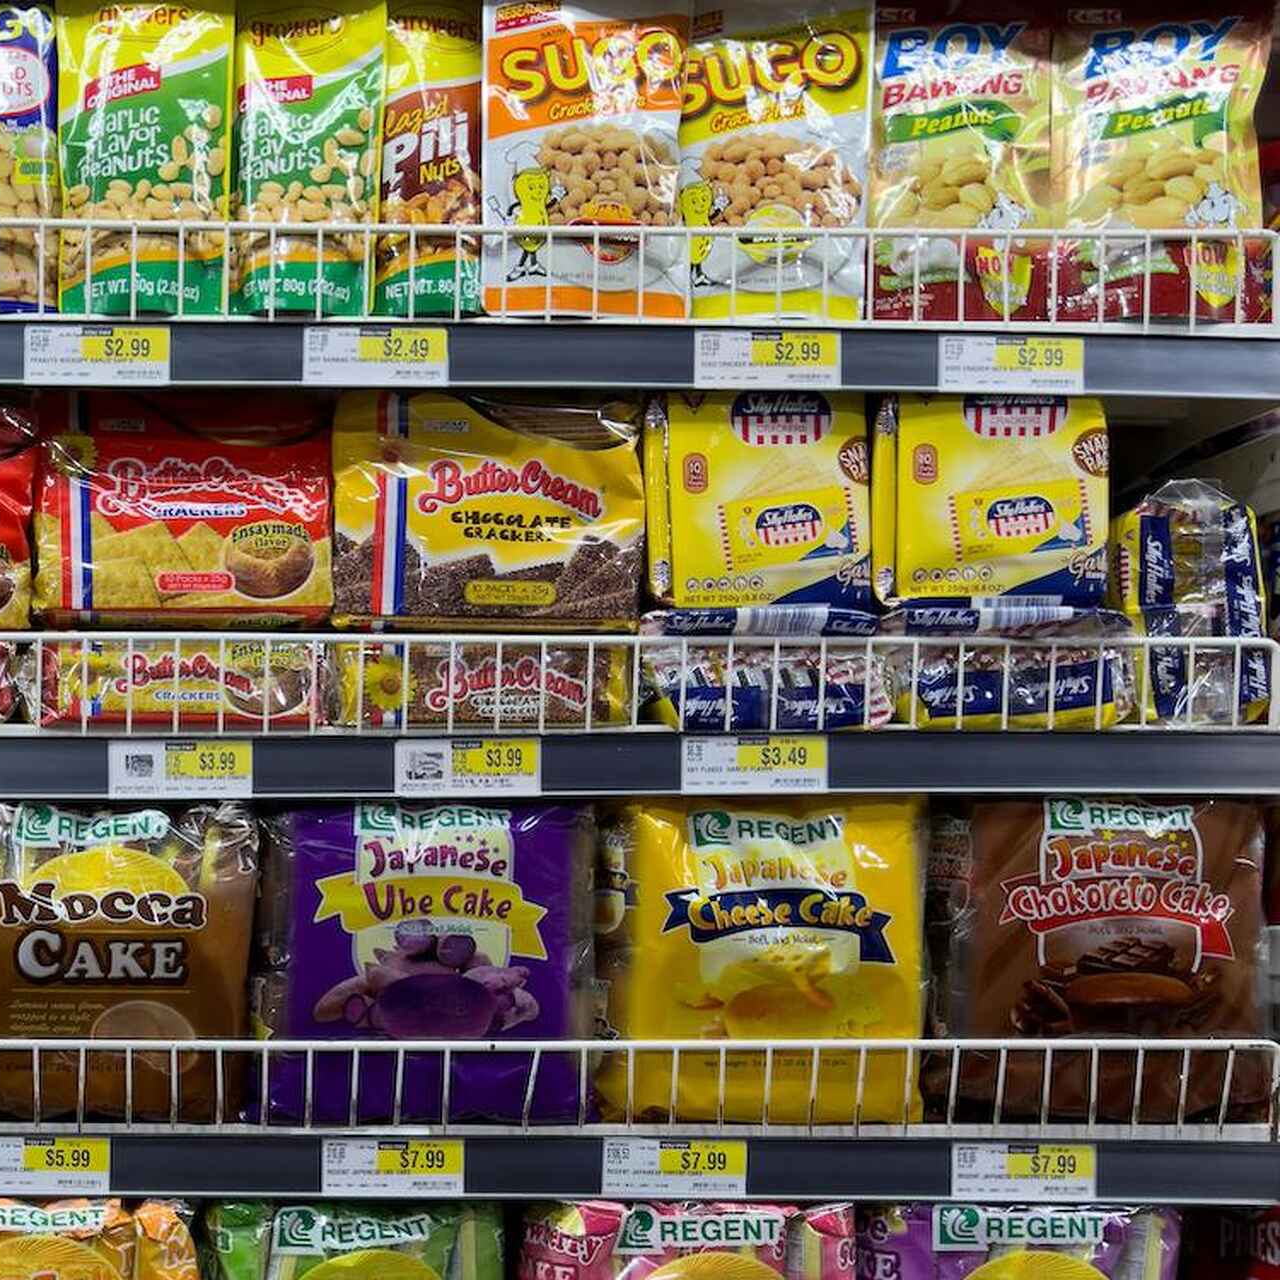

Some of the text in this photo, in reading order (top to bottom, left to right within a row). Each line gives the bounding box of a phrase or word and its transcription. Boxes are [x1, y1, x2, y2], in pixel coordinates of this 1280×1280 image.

[881, 22, 1028, 81] BOY
[501, 26, 686, 103] SUGO
[683, 30, 860, 119] SUGO
[420, 157, 461, 183] Nuts
[105, 338, 151, 358] $2.99
[383, 337, 430, 357] $2.49
[772, 342, 818, 362] $2.99
[1018, 348, 1064, 368] $2.99
[417, 459, 602, 519] Butter Cream
[450, 510, 571, 530] CHOCOLATE
[199, 751, 236, 771] $3.99
[486, 748, 523, 768] $3.99
[760, 748, 807, 768] $3.49
[400, 807, 510, 830] REGENT
[1089, 806, 1193, 829] REGENT
[737, 815, 844, 845] REGENT
[1047, 837, 1197, 879] Japanese
[362, 882, 514, 919] Ube Cake
[1007, 876, 1231, 923] Chokoreto Cake
[687, 894, 874, 931] Cheese Cake
[17, 929, 187, 983] CAKE
[46, 1150, 90, 1169] $5.99
[400, 1151, 445, 1170] $7.99
[681, 1152, 726, 1172] $7.99
[1030, 1155, 1076, 1175] $7.99
[320, 1217, 427, 1244] REGENT
[660, 1218, 782, 1242] REGENT
[985, 1216, 1104, 1239] REGENT
